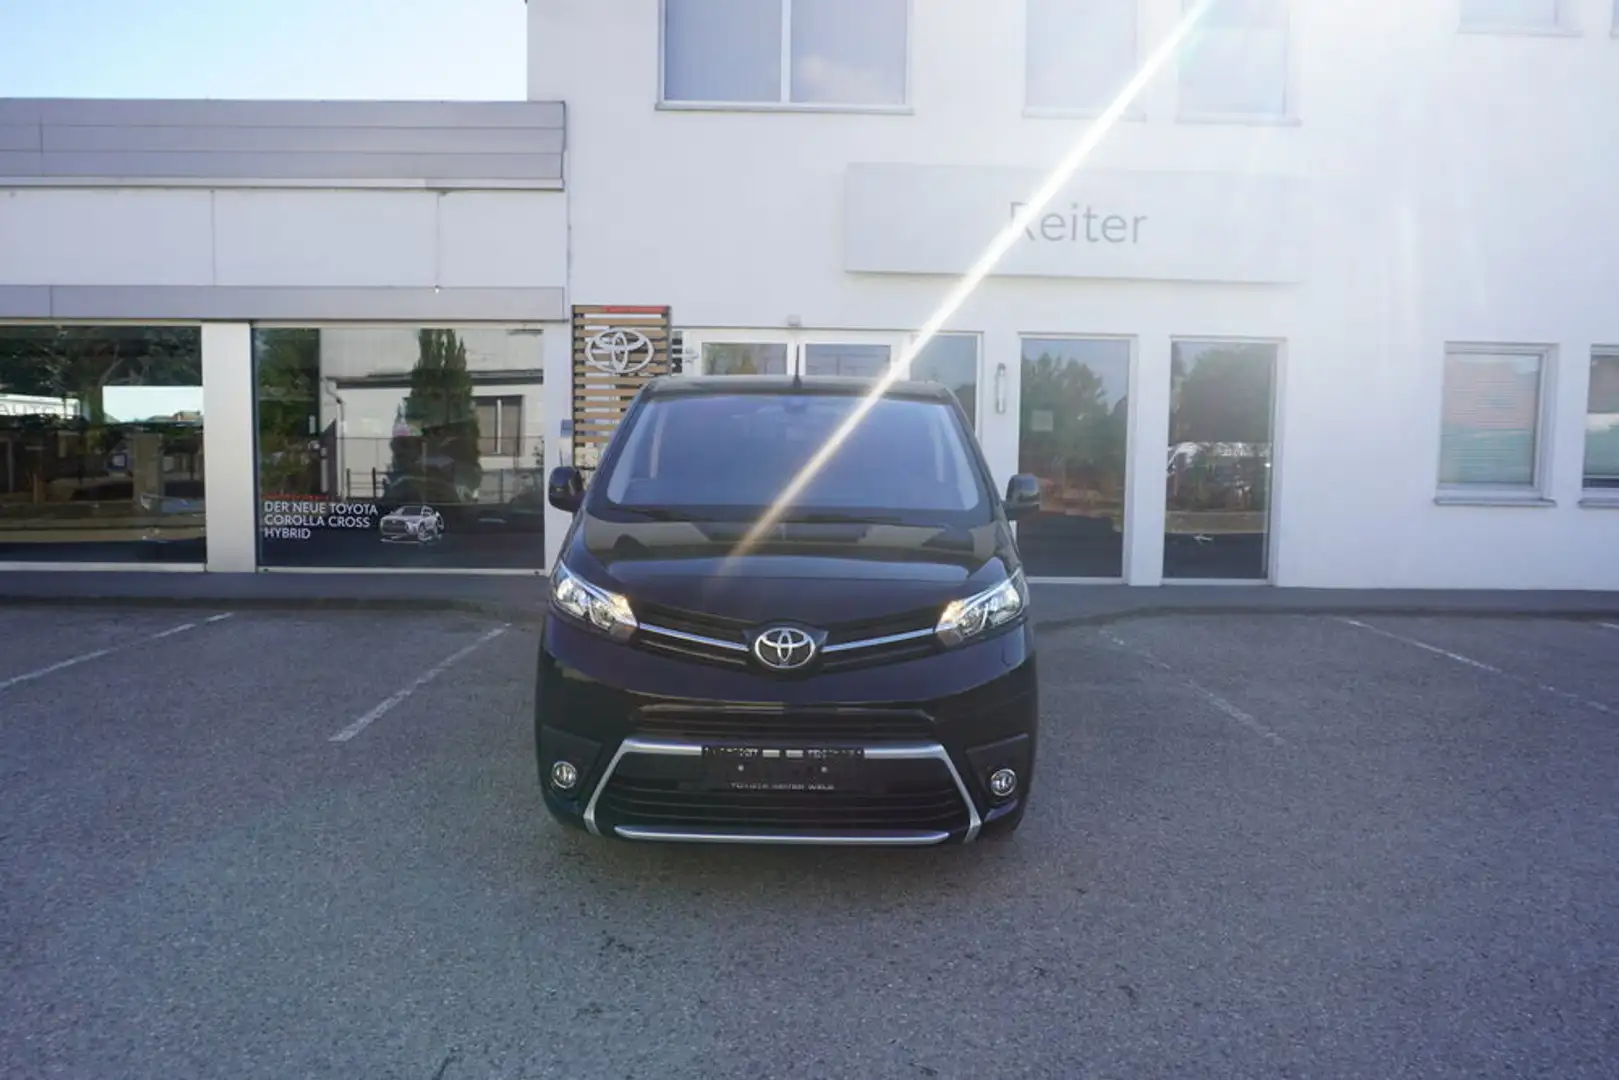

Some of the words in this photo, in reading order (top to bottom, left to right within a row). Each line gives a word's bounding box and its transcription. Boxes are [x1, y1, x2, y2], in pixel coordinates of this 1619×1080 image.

[1009, 201, 1148, 244] Reiter
[264, 501, 290, 513] DER
[292, 502, 326, 514] NEUE
[329, 503, 379, 515] TOYOTA
[264, 514, 325, 526] COROLLA
[328, 516, 371, 528] CROSS
[264, 527, 312, 539] HYBRID
